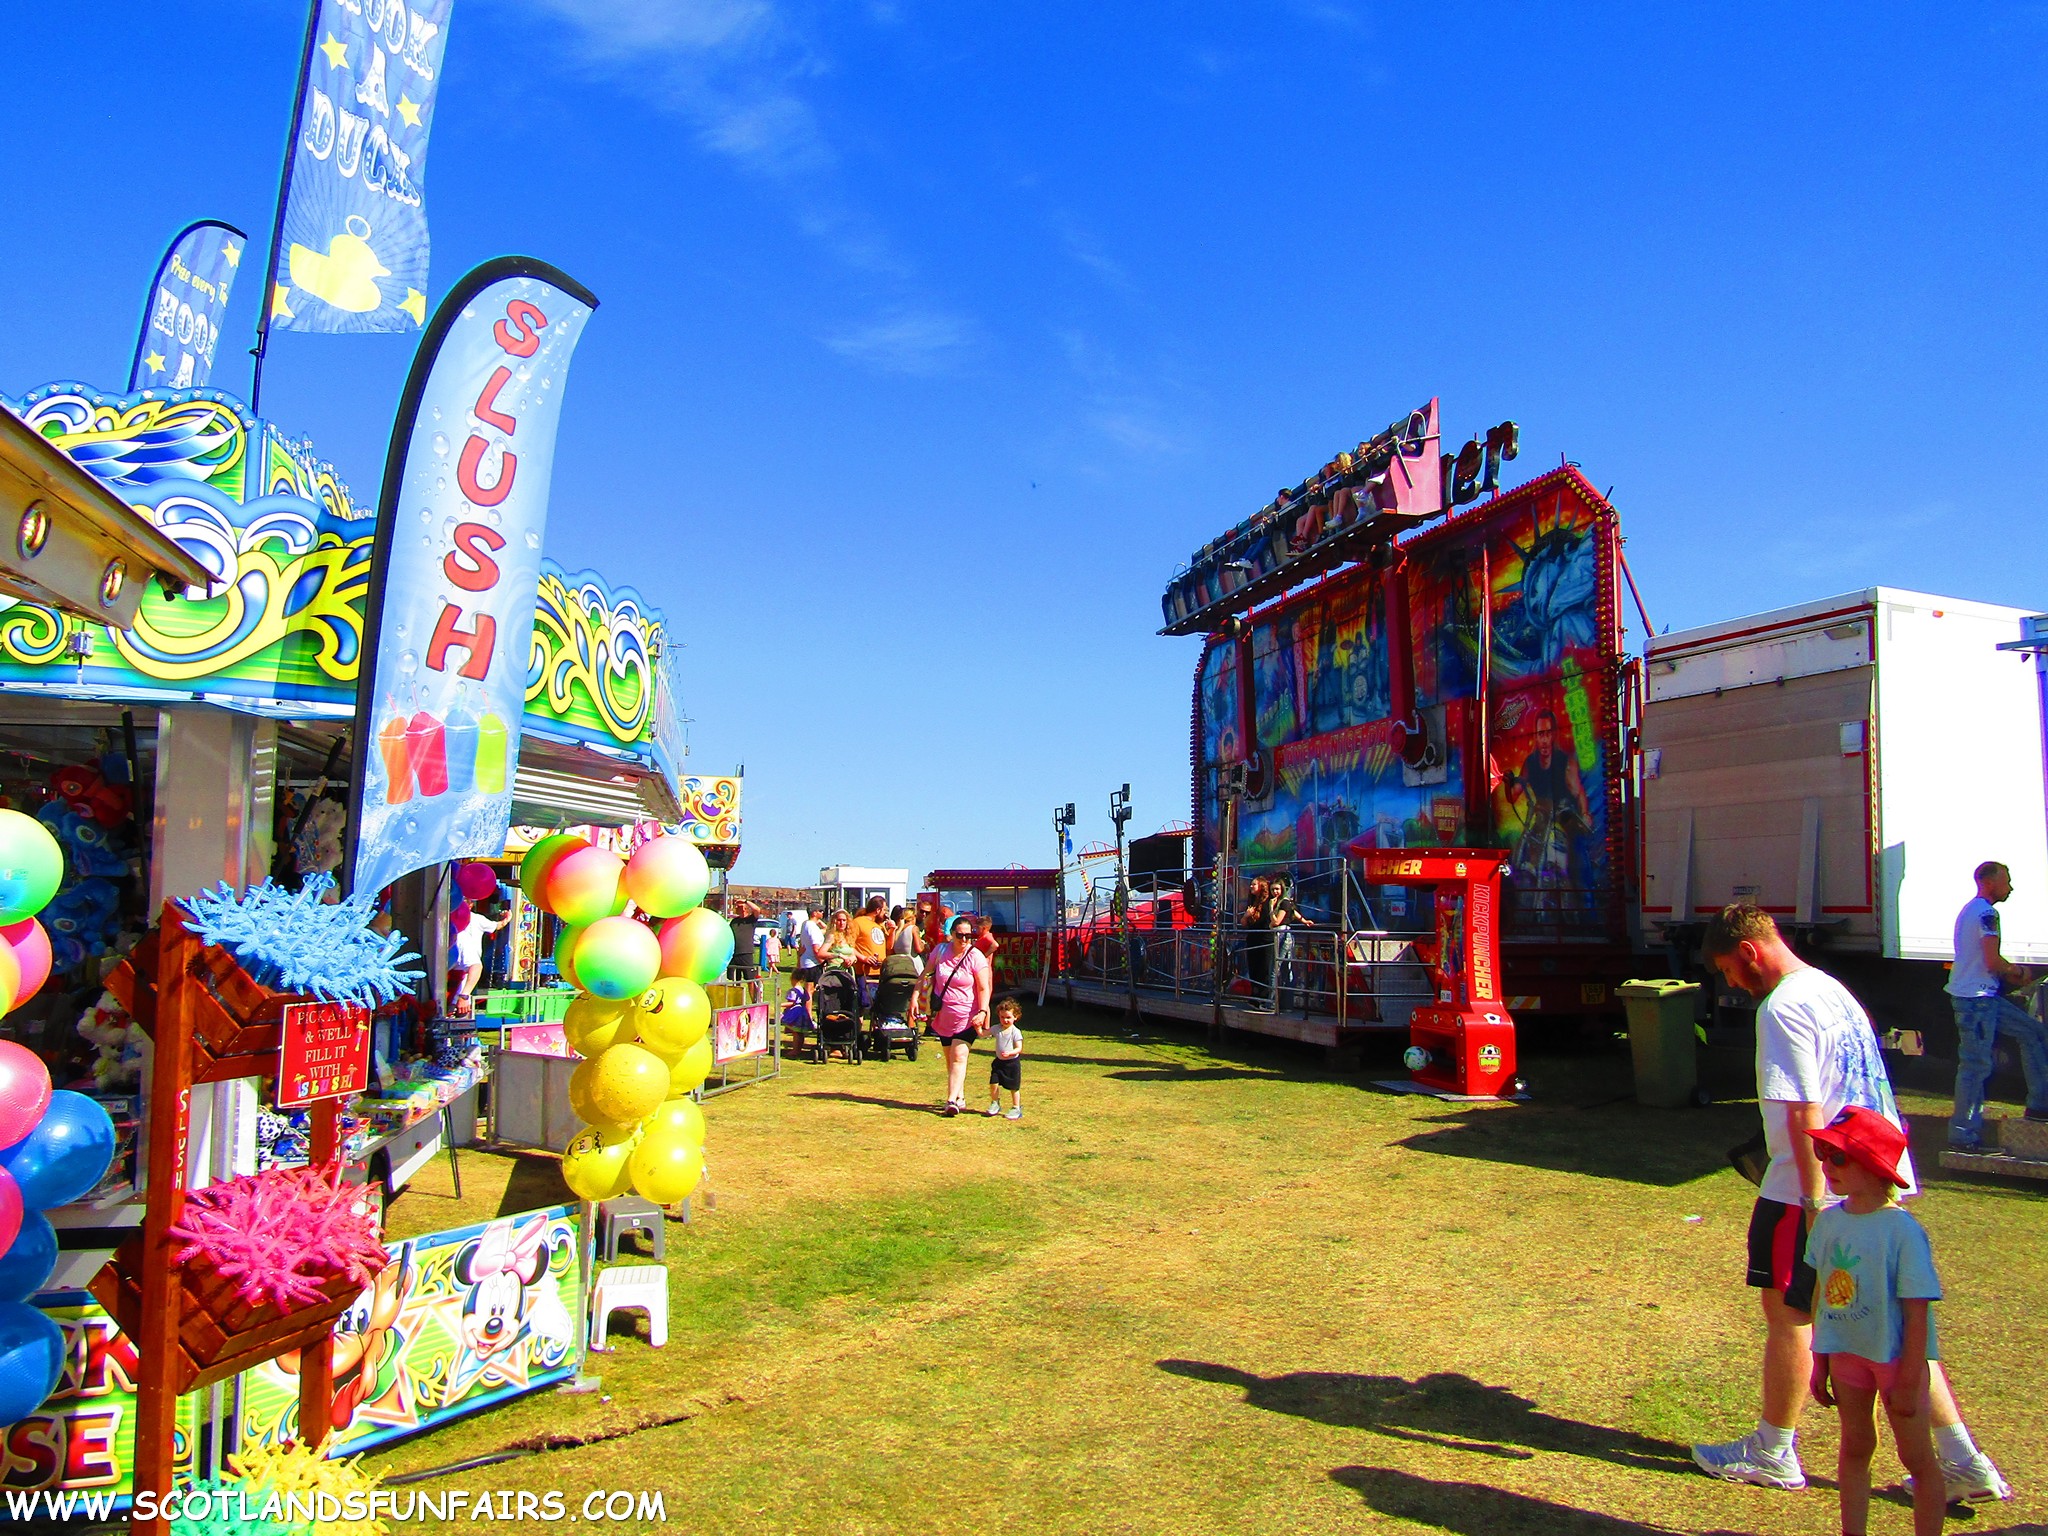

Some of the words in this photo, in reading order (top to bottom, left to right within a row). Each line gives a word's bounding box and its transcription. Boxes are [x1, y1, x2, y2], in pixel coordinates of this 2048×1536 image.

[336, 0, 439, 81] OOK
[355, 42, 390, 119] A
[303, 84, 421, 208] DUCK
[170, 254, 191, 284] Prize
[191, 275, 216, 303] every
[425, 298, 549, 682] SLUSH
[1373, 859, 1422, 875] CHER
[1472, 883, 1493, 1000] KICKPUNCHER
[296, 1010, 325, 1025] PICK
[305, 1031, 315, 1044] &
[305, 1048, 332, 1063] FILL
[334, 1046, 347, 1059] IT
[310, 1063, 341, 1078] WITH
[175, 1089, 190, 1191] SLUSH
[0, 1410, 121, 1487] SE
